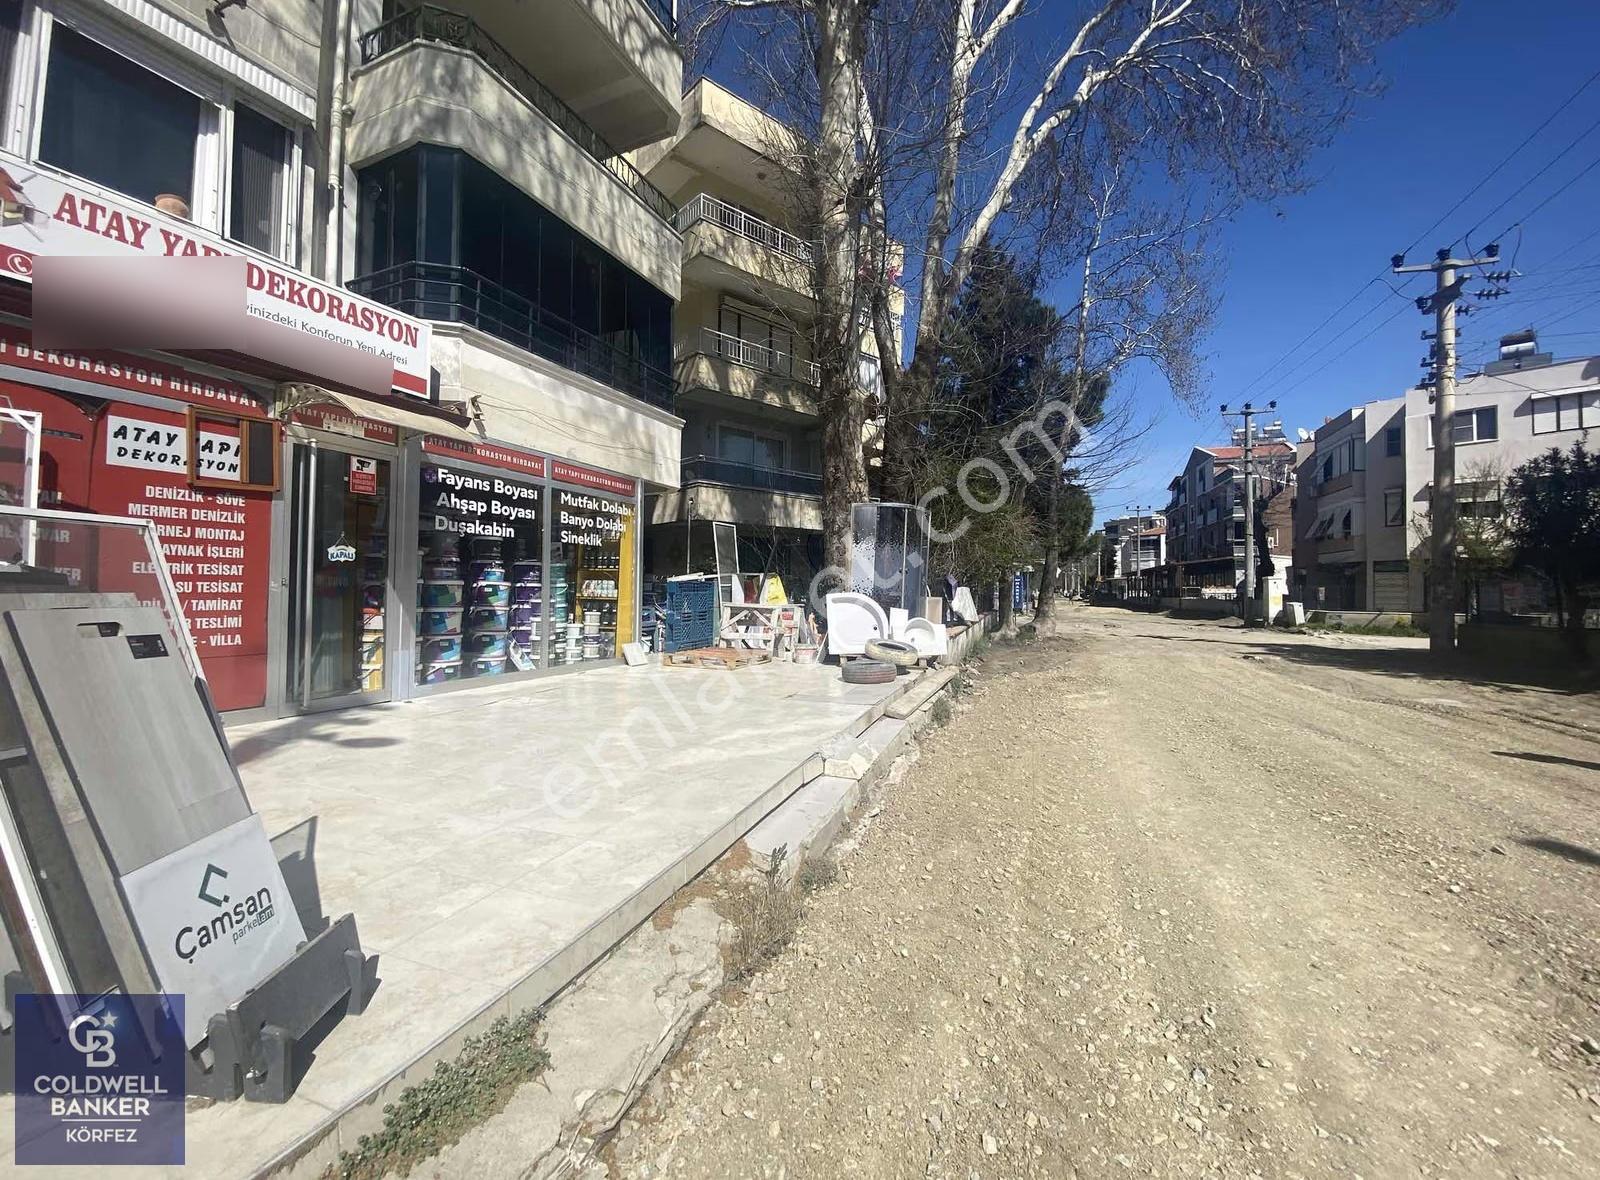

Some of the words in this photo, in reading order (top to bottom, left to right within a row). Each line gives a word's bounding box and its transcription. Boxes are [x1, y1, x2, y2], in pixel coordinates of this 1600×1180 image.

[54, 192, 151, 250] ATAY
[247, 262, 419, 348] DEKORASYON
[301, 321, 353, 347] Konforun
[356, 339, 377, 355] Yeni
[379, 349, 408, 365] Adresi
[16, 343, 162, 387] DEKORASYON
[169, 376, 259, 408] HIRDAVAT
[113, 425, 179, 447] ATAY
[196, 437, 240, 457] API
[116, 446, 239, 473] DEKORSYON
[146, 485, 204, 503] DENİZLİK
[437, 468, 490, 490] Fayans
[494, 479, 538, 500] Boyası
[128, 503, 188, 520] MERMER
[191, 508, 246, 524] DENİZLİK
[436, 492, 482, 516] Ahşap
[491, 500, 535, 520] Boyası
[560, 491, 599, 511] Mutfak
[601, 500, 631, 516] Dolabı
[434, 515, 515, 538] Duşakabin
[560, 511, 594, 530] Banyo
[596, 516, 626, 532] Dolabı
[195, 527, 245, 541] MONTAJ
[560, 530, 602, 547] Sineklik
[160, 543, 204, 557] AYNAK
[207, 545, 244, 559] İŞLERİ
[330, 551, 354, 560] KAPALI
[196, 562, 244, 576] TESİSAT
[176, 581, 193, 593] SU
[196, 579, 244, 594] TESİSAT
[191, 597, 243, 611] TAMİRAT
[195, 614, 242, 629] TESLİMİ
[209, 633, 242, 647] VİLLA
[175, 887, 272, 964] Çamsan
